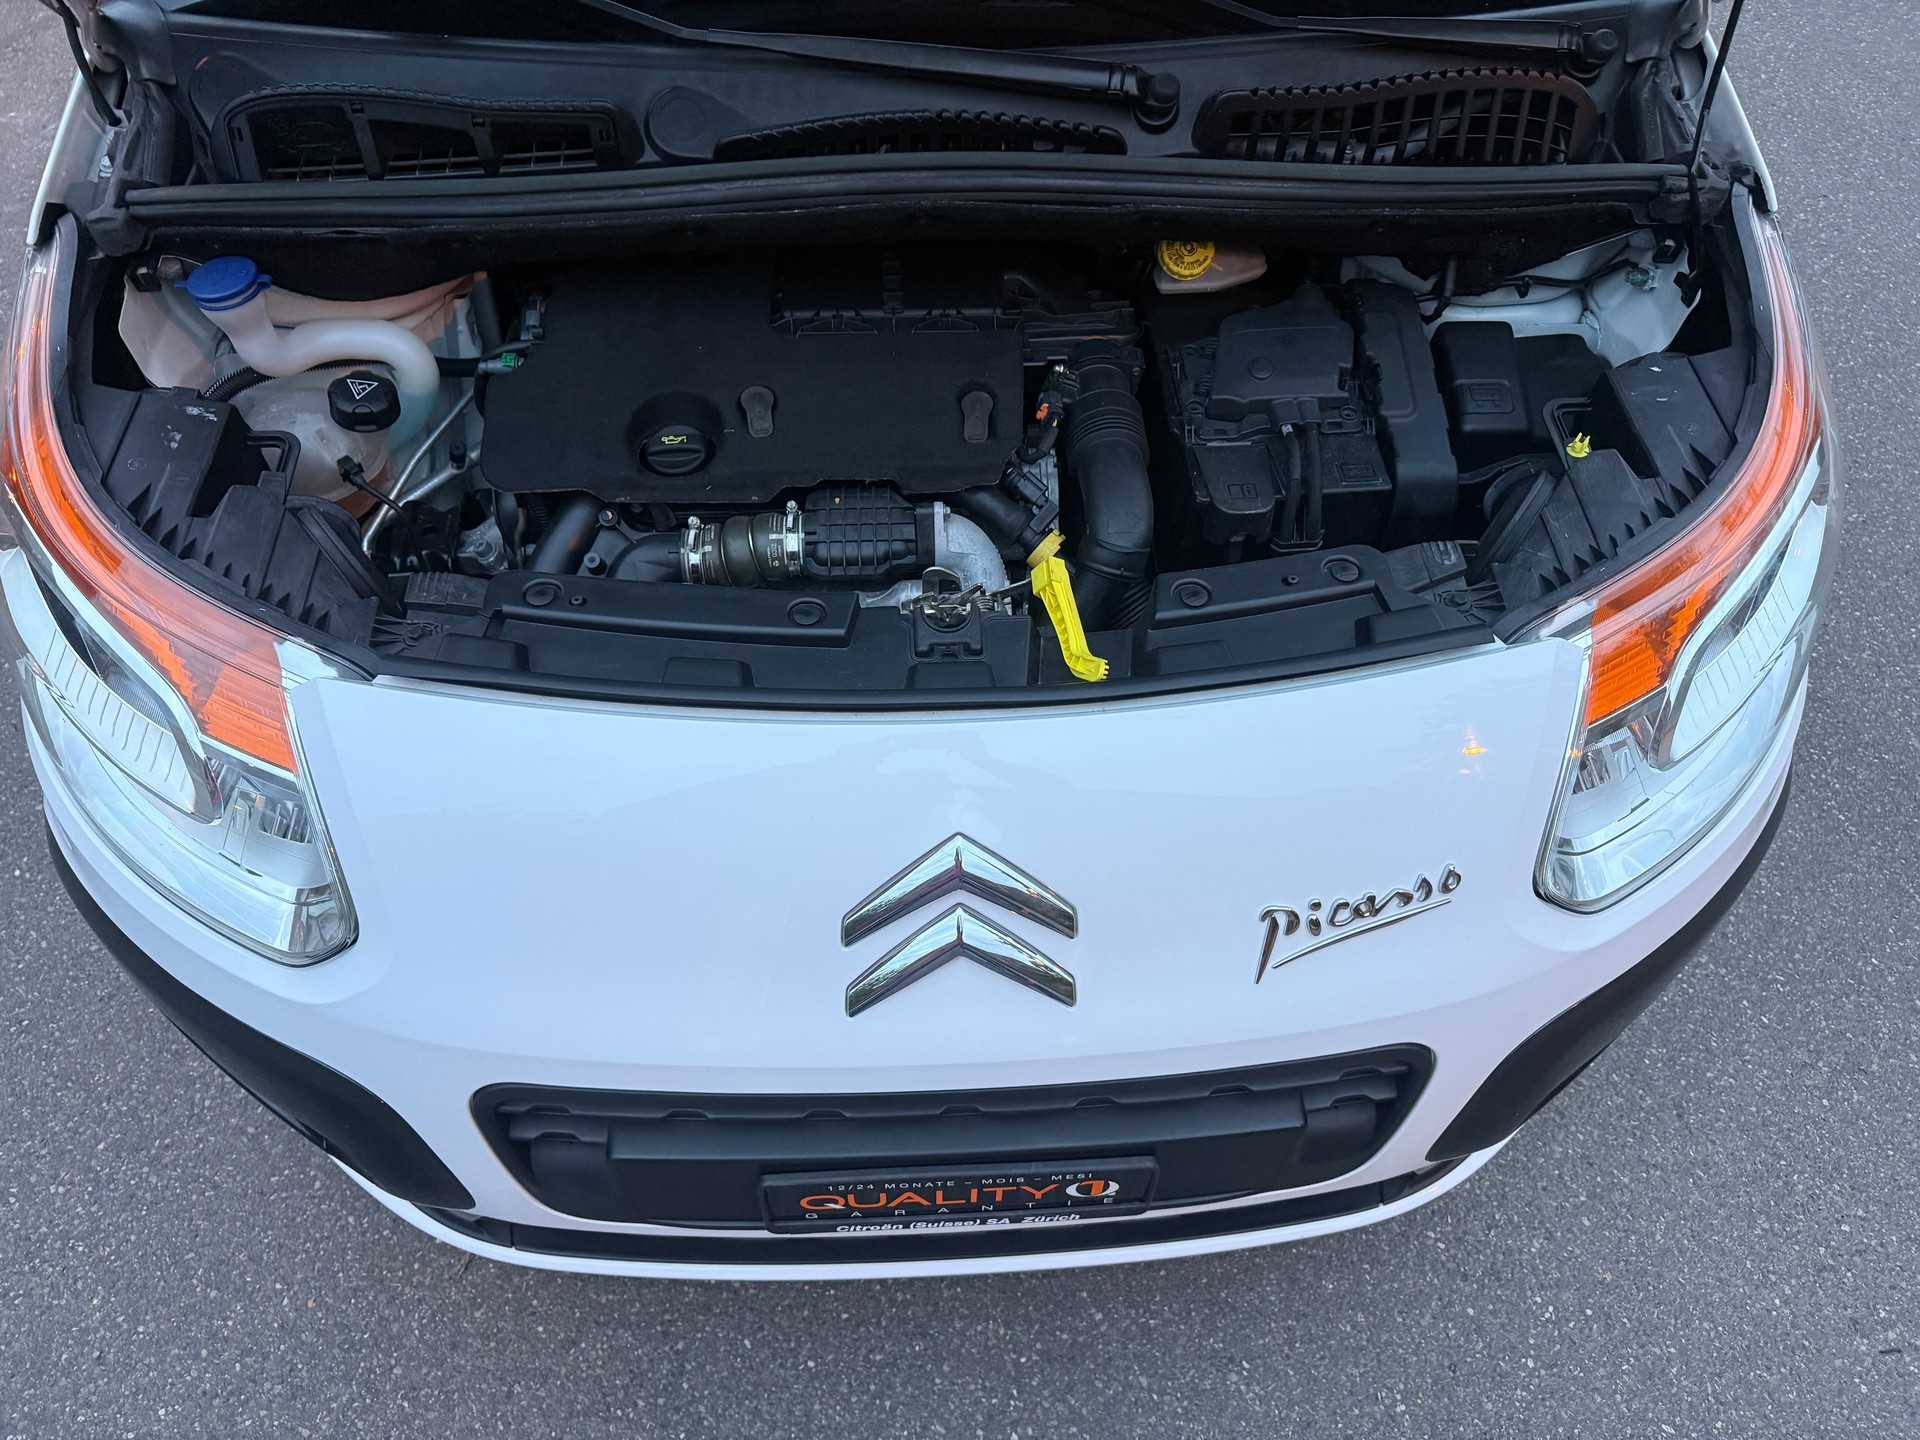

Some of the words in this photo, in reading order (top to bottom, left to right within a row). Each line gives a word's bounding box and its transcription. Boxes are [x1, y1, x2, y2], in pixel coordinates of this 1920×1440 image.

[827, 1183, 874, 1191] 12/24
[884, 1181, 955, 1189] MONATE
[982, 1176, 1024, 1184] MOIS
[1051, 1172, 1092, 1180] MESI
[800, 1183, 1060, 1210] QUALITY
[805, 1197, 1114, 1219] GARANTIE
[836, 1222, 903, 1232] Citroën
[909, 1219, 981, 1231] (Suisse)
[985, 1217, 1011, 1226] SA
[1021, 1213, 1081, 1224] Zürich
